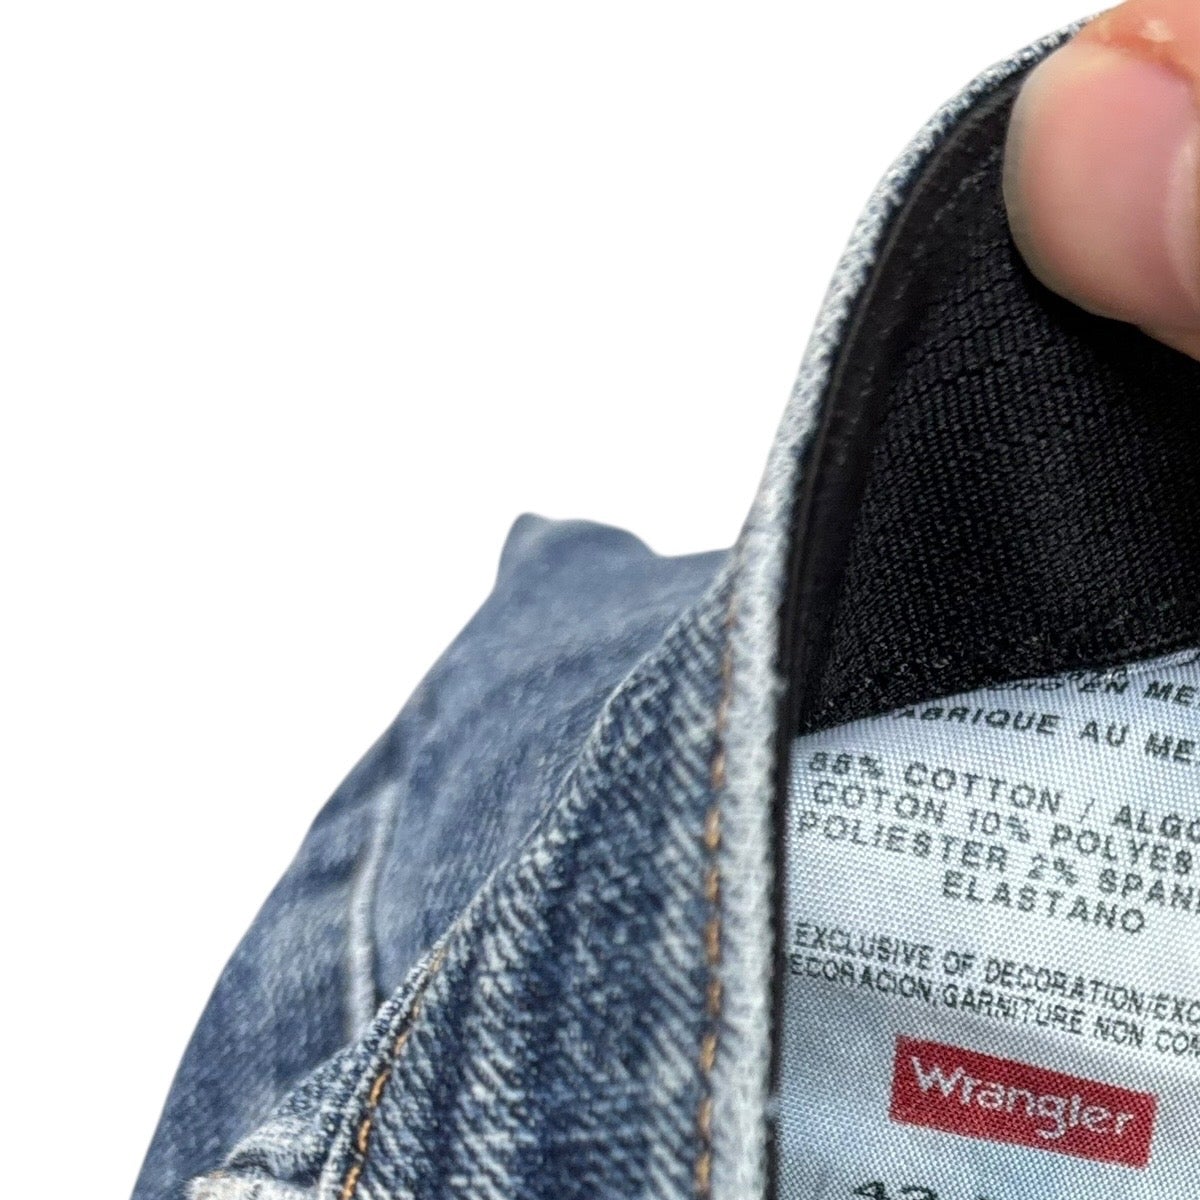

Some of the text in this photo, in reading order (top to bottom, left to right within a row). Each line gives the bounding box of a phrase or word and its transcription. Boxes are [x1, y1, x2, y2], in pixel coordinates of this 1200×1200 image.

[889, 704, 1061, 735] ABRIQUE
[1080, 719, 1129, 748] AU
[813, 779, 948, 824] COTON
[967, 807, 1030, 844] 10%
[904, 760, 1062, 816] COTTON
[798, 809, 1008, 875] POLIESTER
[941, 869, 1145, 935] ELASTANO
[792, 922, 933, 971] EXCLUSIVE
[943, 950, 976, 978] OF
[1093, 1014, 1145, 1048] NON
[911, 1056, 1134, 1140] Wrangler
